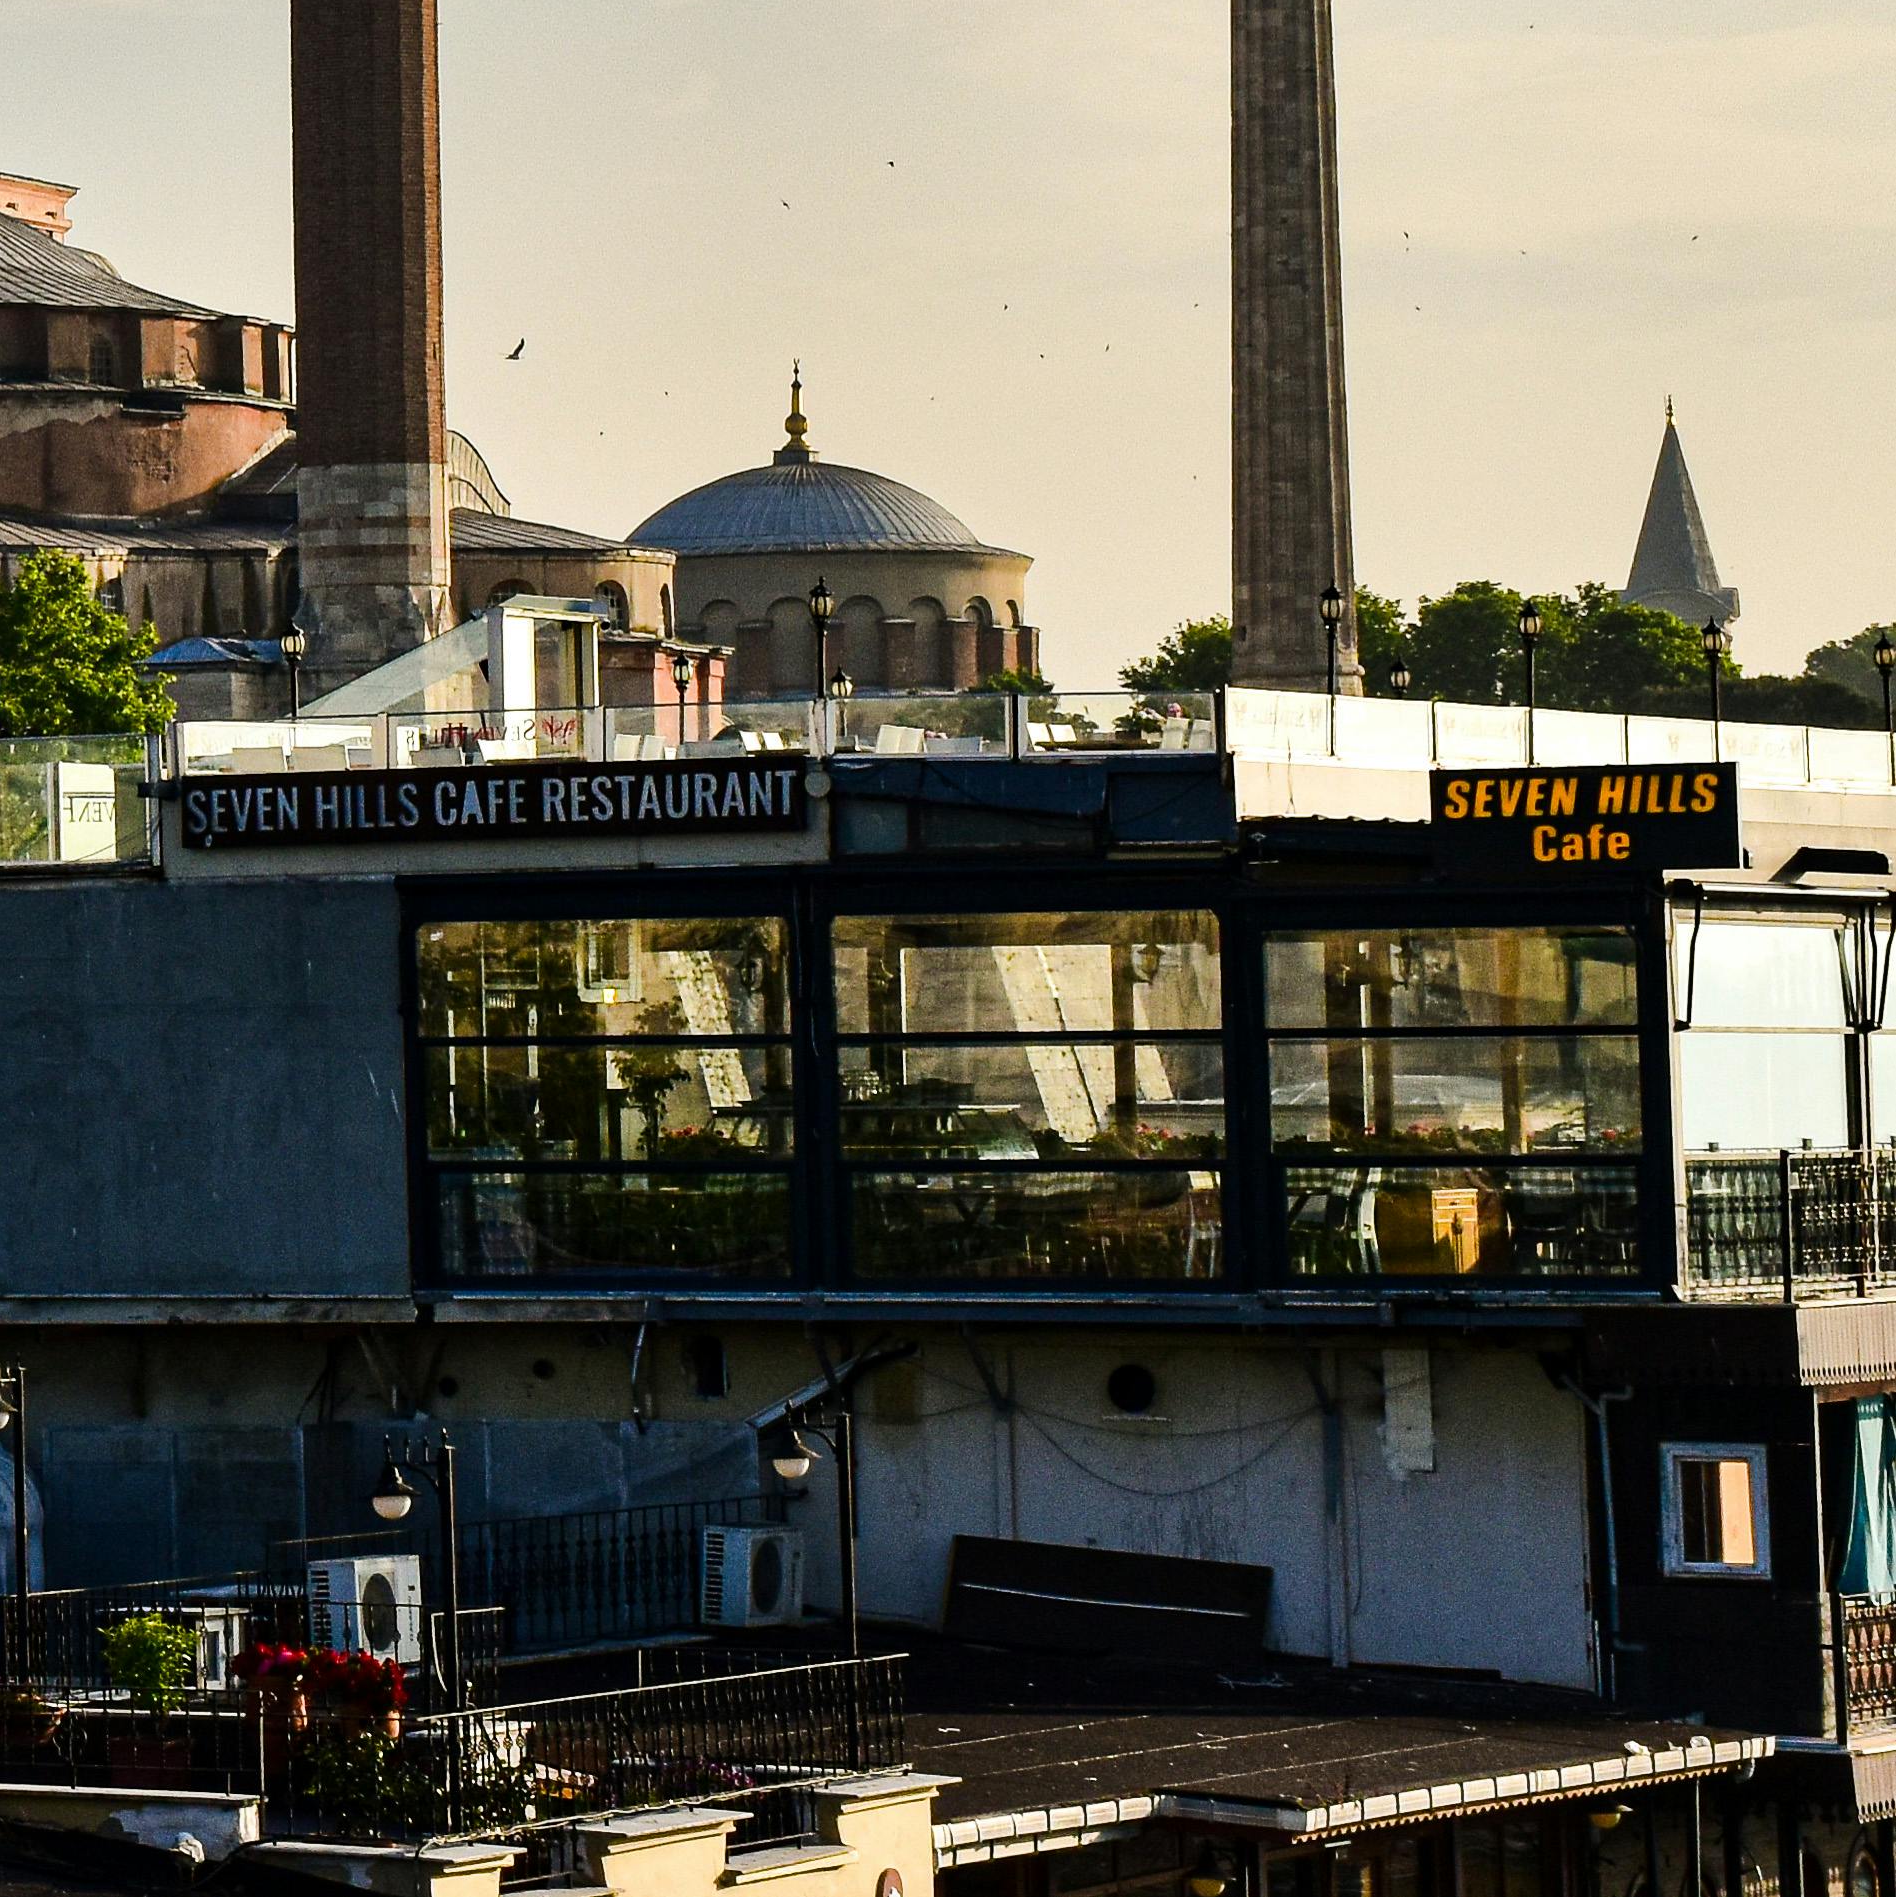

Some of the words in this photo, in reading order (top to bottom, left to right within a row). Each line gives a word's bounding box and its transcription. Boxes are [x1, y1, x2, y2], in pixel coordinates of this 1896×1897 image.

[188, 786, 299, 834] SEVEN
[314, 783, 420, 830] HILLS
[434, 778, 527, 826] CAFE
[542, 769, 797, 822] RESTAURANT
[1444, 779, 1578, 819] SEVEN
[1598, 772, 1718, 815] HILLS
[1533, 823, 1630, 862] Cafe
